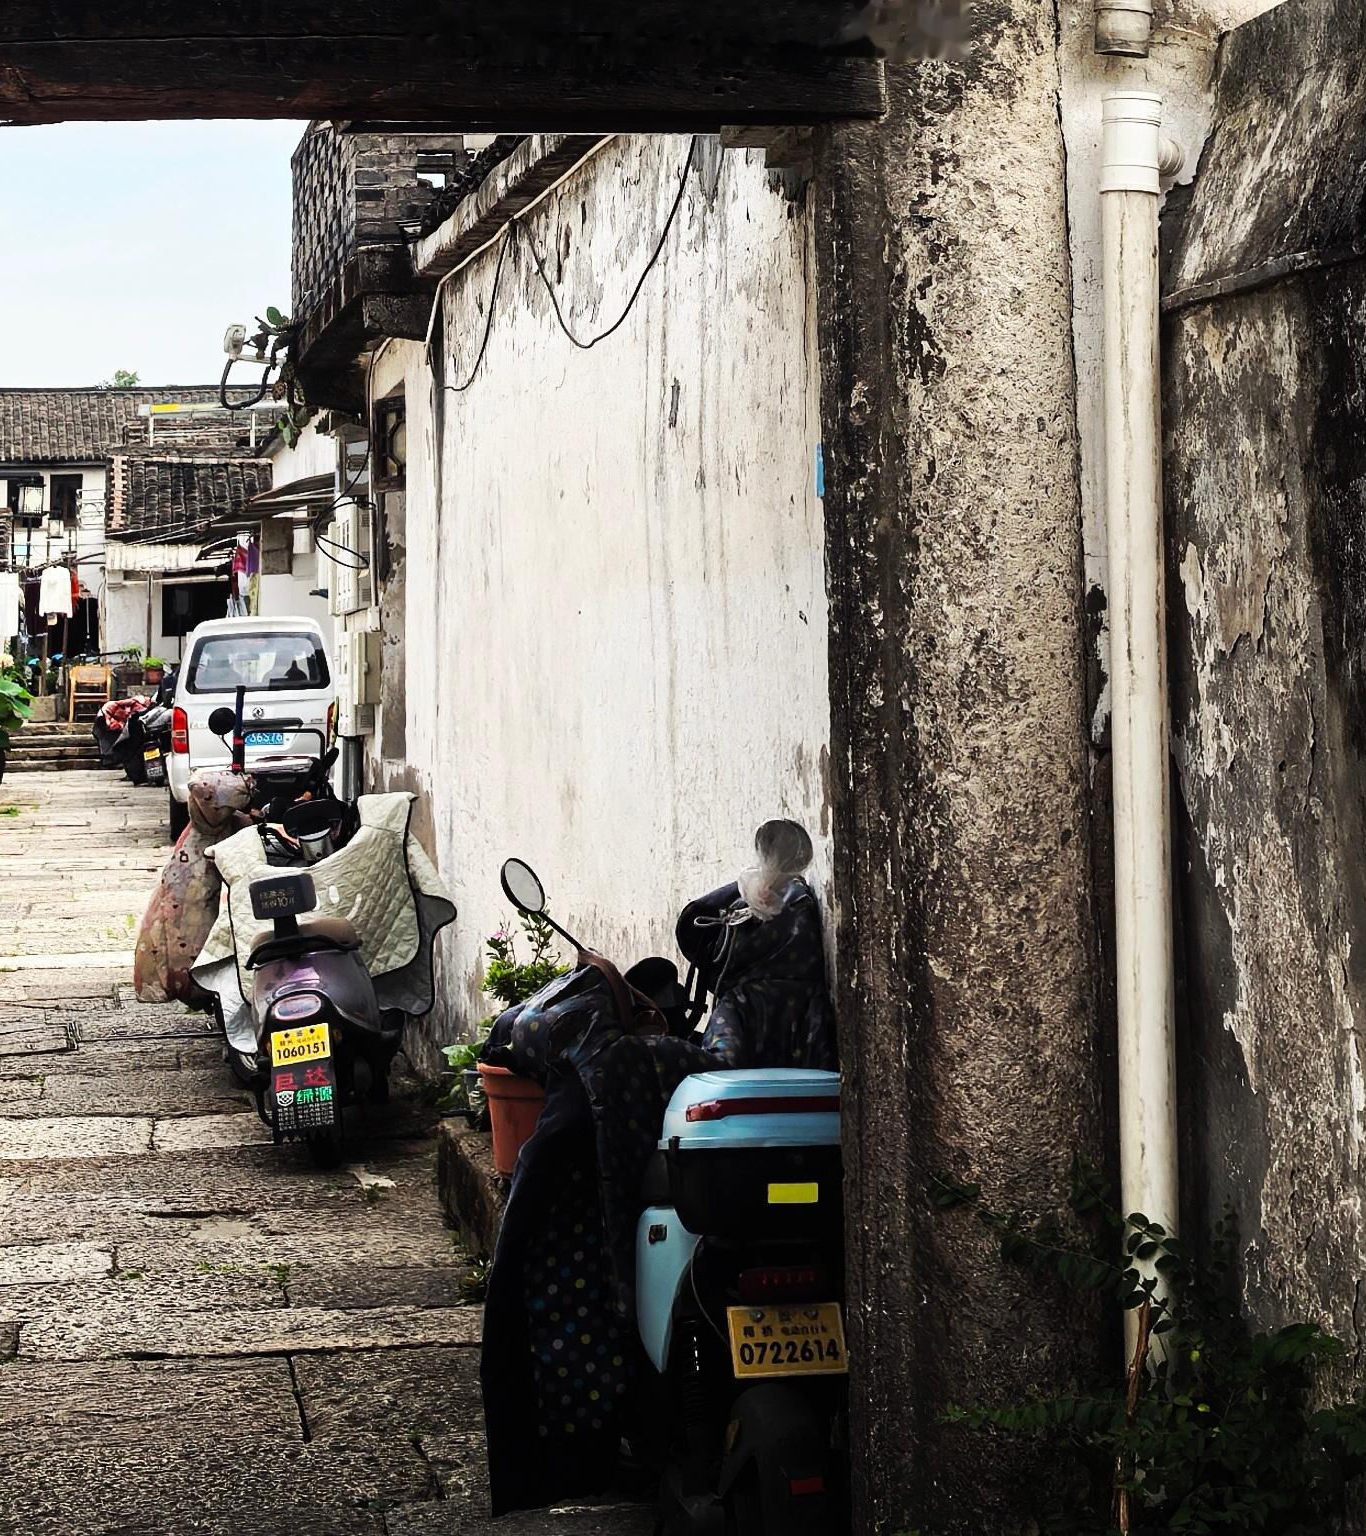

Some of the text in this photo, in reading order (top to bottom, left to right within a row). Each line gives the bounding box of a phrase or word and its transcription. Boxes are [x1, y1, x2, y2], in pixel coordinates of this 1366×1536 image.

[276, 1041, 327, 1061] 1060151
[275, 1066, 331, 1093] 巨达
[296, 1085, 333, 1105] 绿源
[739, 1338, 840, 1366] 0722614
